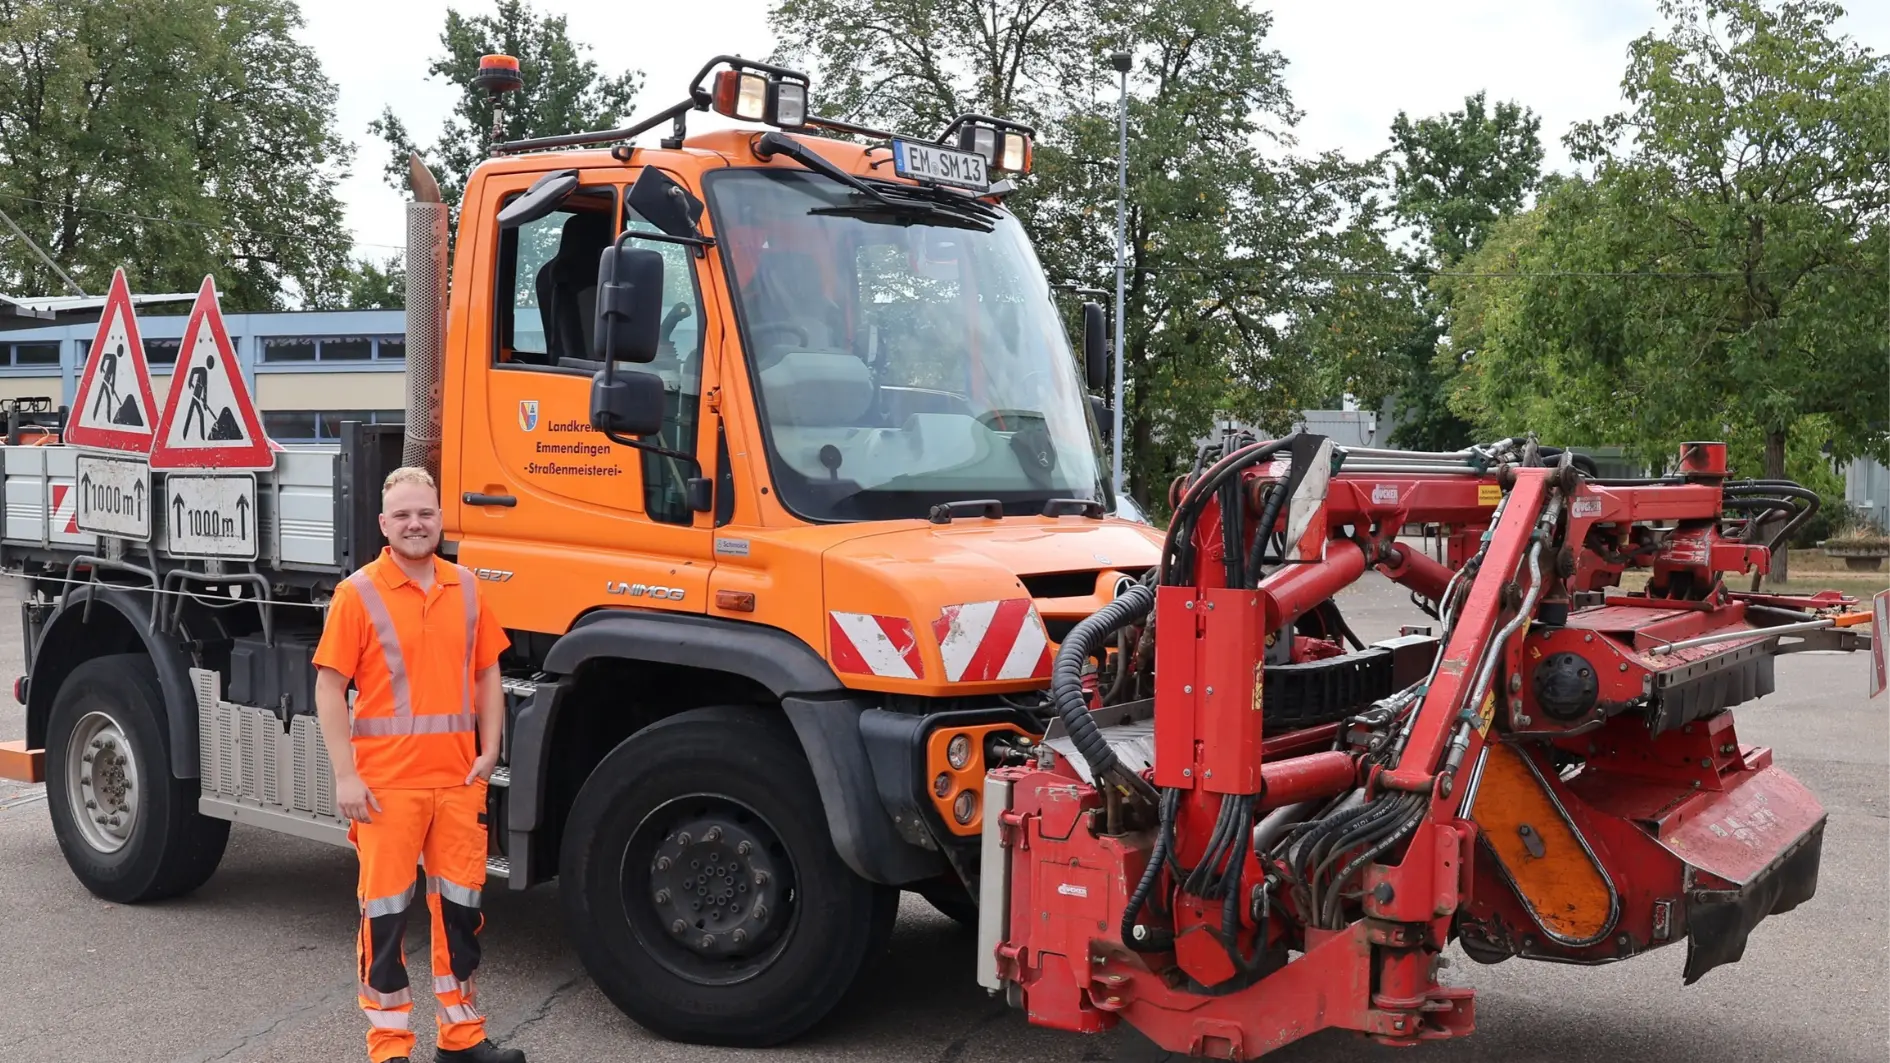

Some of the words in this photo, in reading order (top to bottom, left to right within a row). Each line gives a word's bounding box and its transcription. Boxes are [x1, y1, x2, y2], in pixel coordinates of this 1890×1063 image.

[909, 147, 931, 173] EM
[962, 157, 981, 182] 13
[548, 420, 601, 433] Landkre
[536, 442, 611, 457] Emmendingen
[524, 462, 623, 477] -Straßenmeisterei-
[606, 581, 685, 601] UNIMOG
